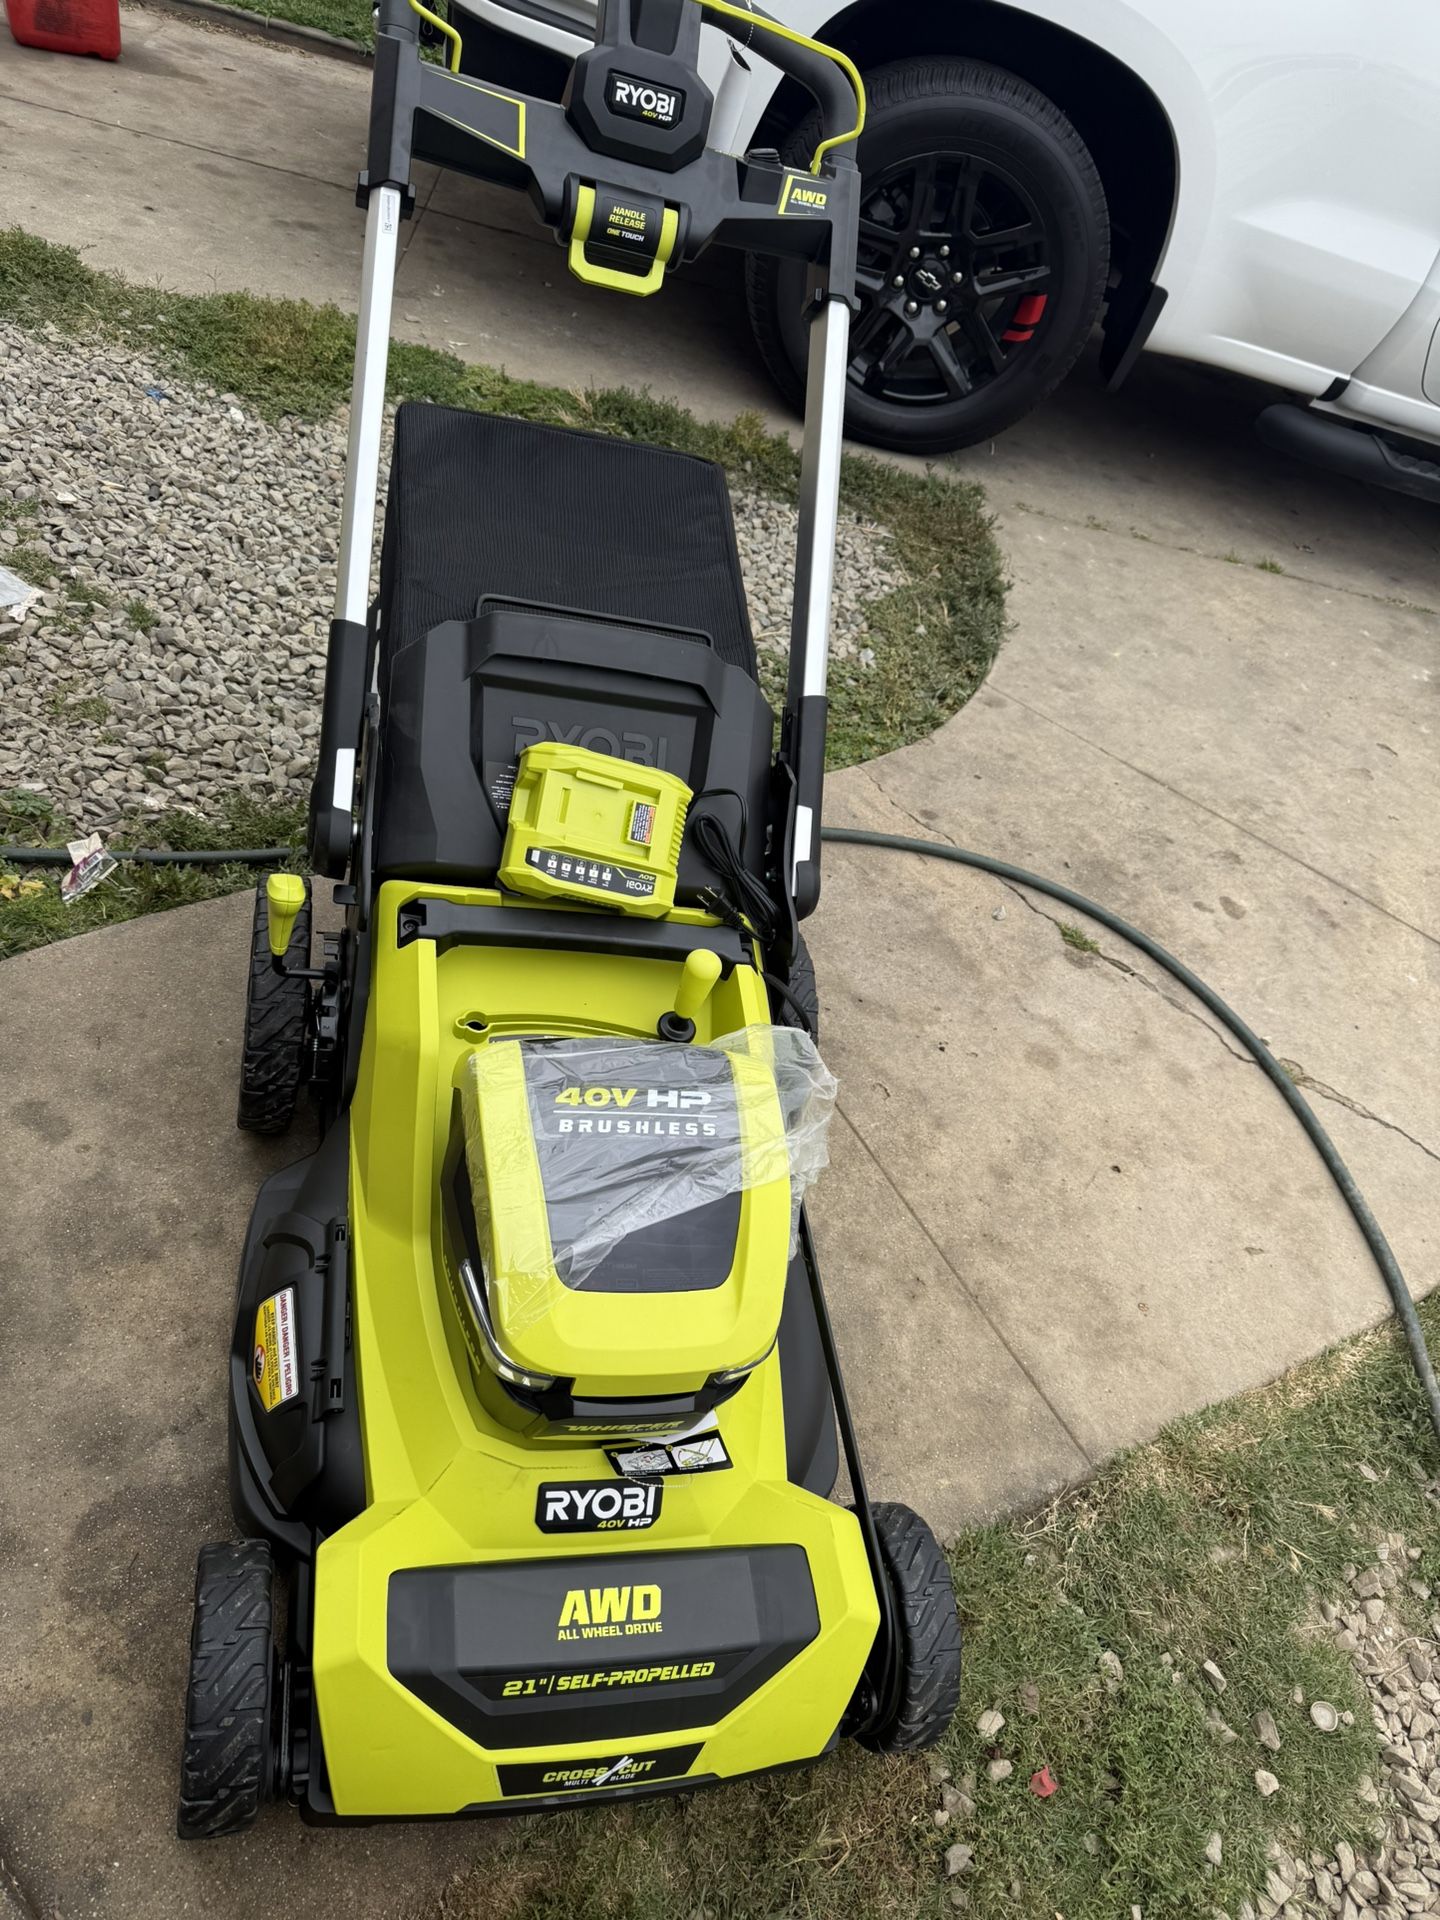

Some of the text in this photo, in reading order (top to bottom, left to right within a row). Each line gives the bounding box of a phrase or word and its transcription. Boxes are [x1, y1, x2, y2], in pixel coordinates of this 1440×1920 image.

[615, 81, 676, 116] RYOBI
[642, 110, 672, 122] 40V HP
[791, 187, 827, 205] AWD
[609, 214, 646, 230] RELEASE
[613, 206, 646, 221] HANDLE
[607, 227, 645, 242] ONE TOUCH
[625, 879, 653, 894] RYOBI
[638, 873, 656, 881] 40V
[554, 1087, 713, 1109] 40V HP
[558, 1118, 717, 1137] BRUSHLESS
[280, 1293, 288, 1323] DANGER
[281, 1326, 290, 1358] DANGER
[284, 1363, 292, 1396] PELIGRO
[545, 1486, 656, 1521] RYOBI
[597, 1517, 653, 1529] 40V HP
[558, 1584, 662, 1627] AWD
[558, 1622, 663, 1641] ALL WHEEL DRIVE
[556, 1661, 715, 1691] SELF-PROPELLED
[542, 1760, 657, 1783] CROSS CUT
[564, 1773, 636, 1787] MULTI BLADE
